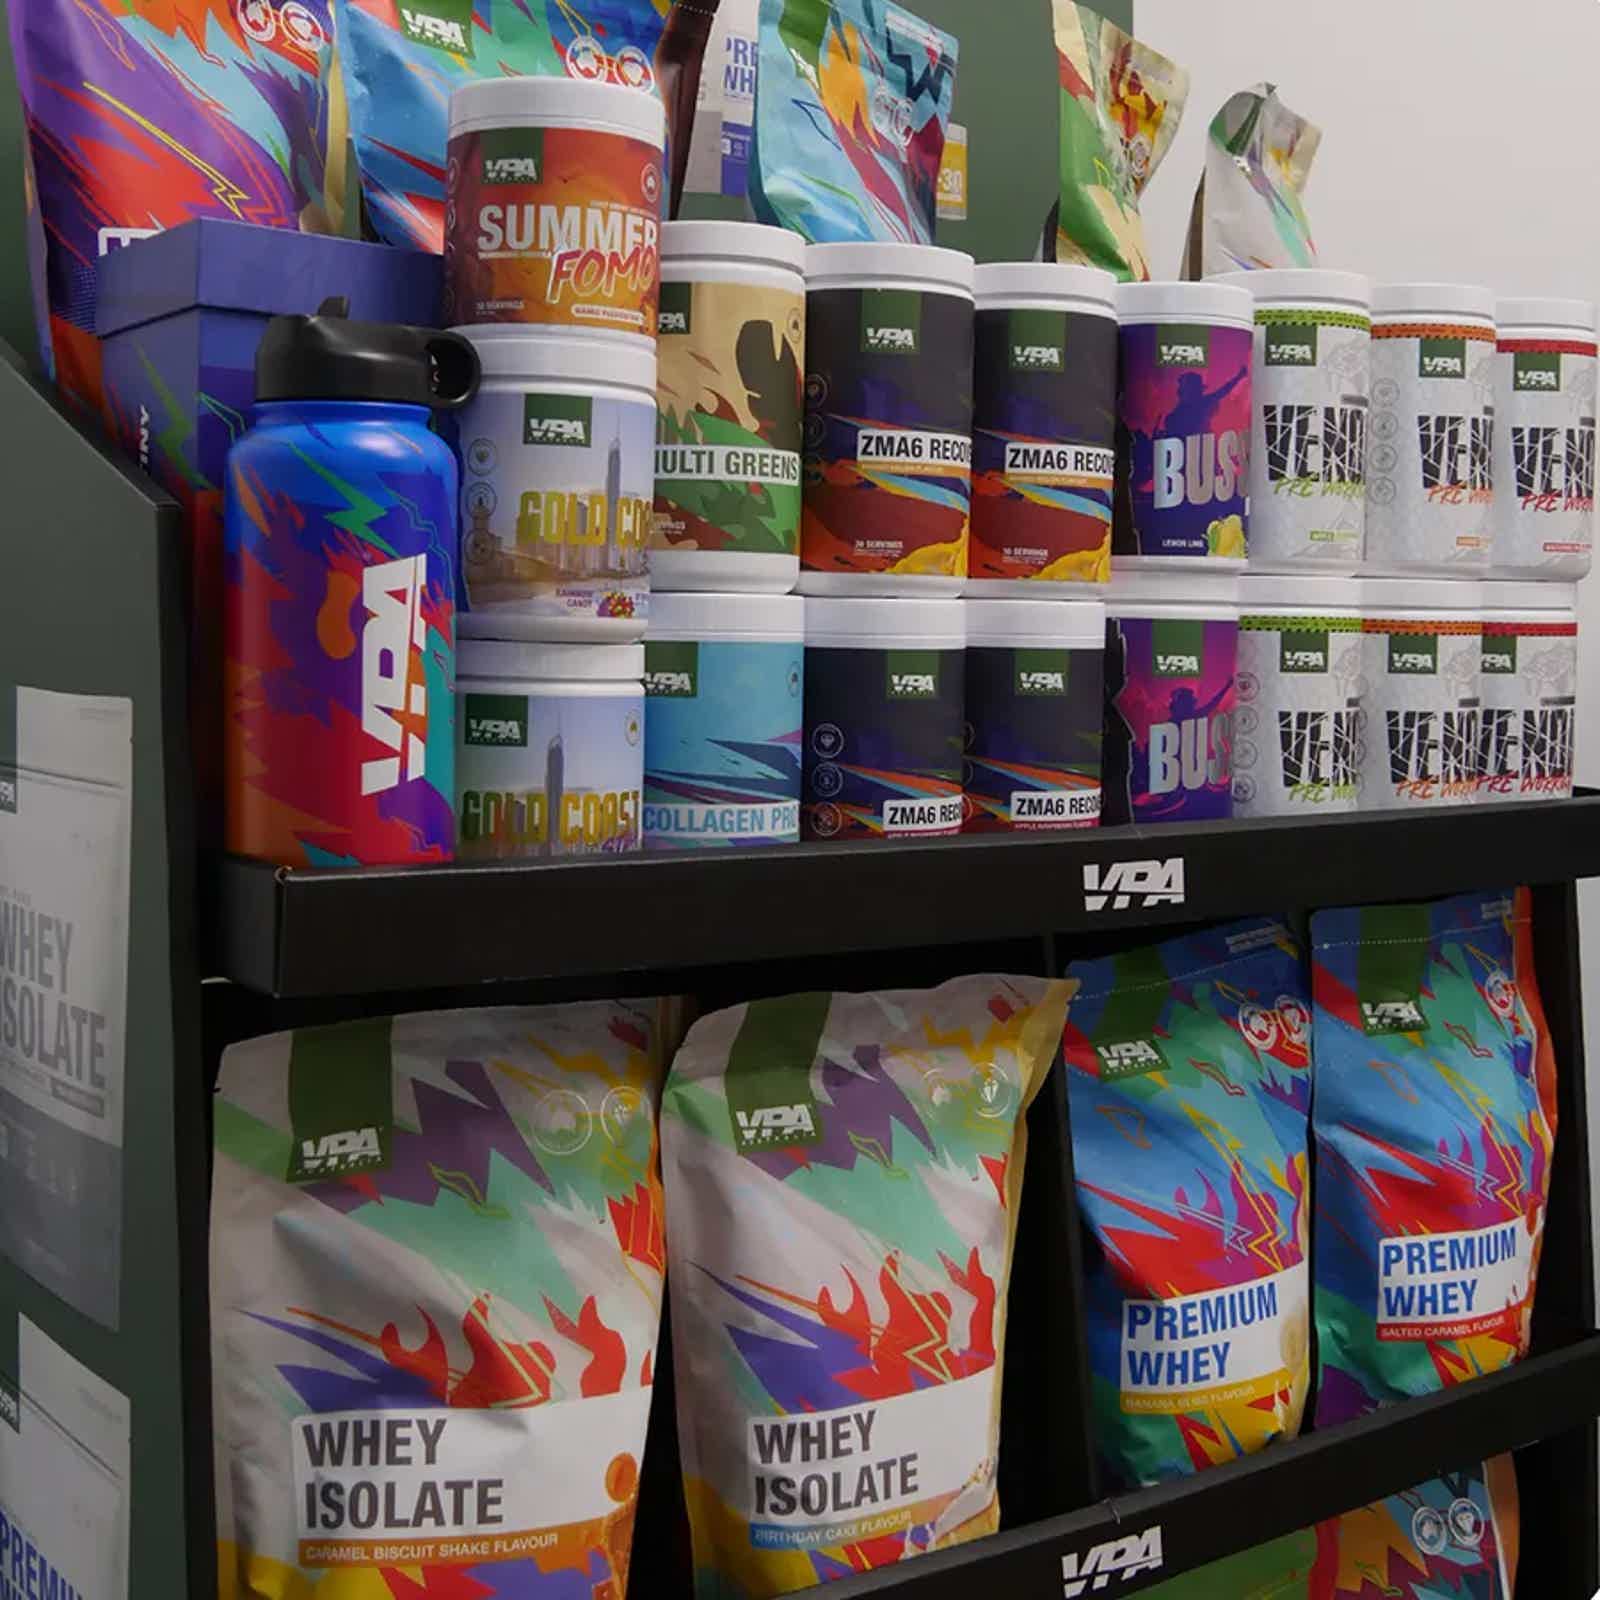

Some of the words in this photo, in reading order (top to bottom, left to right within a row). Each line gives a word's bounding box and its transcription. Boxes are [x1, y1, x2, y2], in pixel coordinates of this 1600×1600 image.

[401, 9, 466, 48] VPA
[485, 158, 538, 179] VPA
[477, 204, 657, 250] SUMMER
[657, 311, 685, 330] PA
[866, 327, 915, 347] VPA
[1013, 346, 1061, 364] VPA
[1160, 345, 1204, 363] VPA
[1269, 344, 1313, 359] VPA
[1423, 357, 1461, 373] VPA
[1517, 371, 1555, 385] VPA
[529, 418, 585, 439] VPA
[860, 434, 923, 459] ZMA6
[725, 450, 799, 482] GREENS
[1008, 448, 1069, 470] ZMA6
[1273, 477, 1315, 498] PRE
[1427, 483, 1464, 505] PRE
[1520, 491, 1559, 513] PRE
[517, 490, 607, 546] GOLD
[1157, 655, 1198, 671] VPA
[1284, 651, 1325, 667] VPA
[1393, 653, 1433, 669] VPA
[362, 553, 427, 796] VPA
[891, 675, 936, 692] VPA
[1020, 672, 1064, 689] VPA
[469, 719, 521, 739] VPA
[1289, 783, 1326, 803] PRE
[1395, 779, 1435, 800] PRE
[1477, 774, 1514, 795] PRE
[460, 789, 546, 842] GOLD
[560, 788, 640, 845] COAST
[888, 805, 936, 826] ZMA6
[1016, 798, 1065, 816] ZMA6
[642, 805, 765, 832] COLLAGEN
[1083, 858, 1184, 912] VPA
[1362, 1000, 1425, 1027] VPA
[1097, 1039, 1159, 1068] VPA
[735, 1103, 816, 1141] VPA
[302, 1126, 382, 1169] VPA
[1383, 1226, 1517, 1277] PREMIUM
[1383, 1279, 1479, 1318] WHEY
[1127, 1281, 1279, 1341] PREMIUM
[1381, 1326, 1424, 1339] SALTED
[1425, 1322, 1472, 1337] CARAMEL
[1127, 1341, 1231, 1387] WHEY
[302, 1418, 448, 1468] WHEY
[753, 1409, 877, 1464] WHEY
[754, 1452, 920, 1516] ISOLATE
[305, 1478, 504, 1530] ISOLATE
[754, 1525, 822, 1545] BIRTHDAY
[825, 1525, 857, 1543] CAKE
[861, 1511, 912, 1535] FLAVOUR
[304, 1544, 369, 1562] CARAMEL
[373, 1543, 434, 1561] BISCUIT
[438, 1540, 490, 1559] SHAKE
[494, 1532, 559, 1554] FLAVOUR
[1061, 1525, 1163, 1599] VPA
